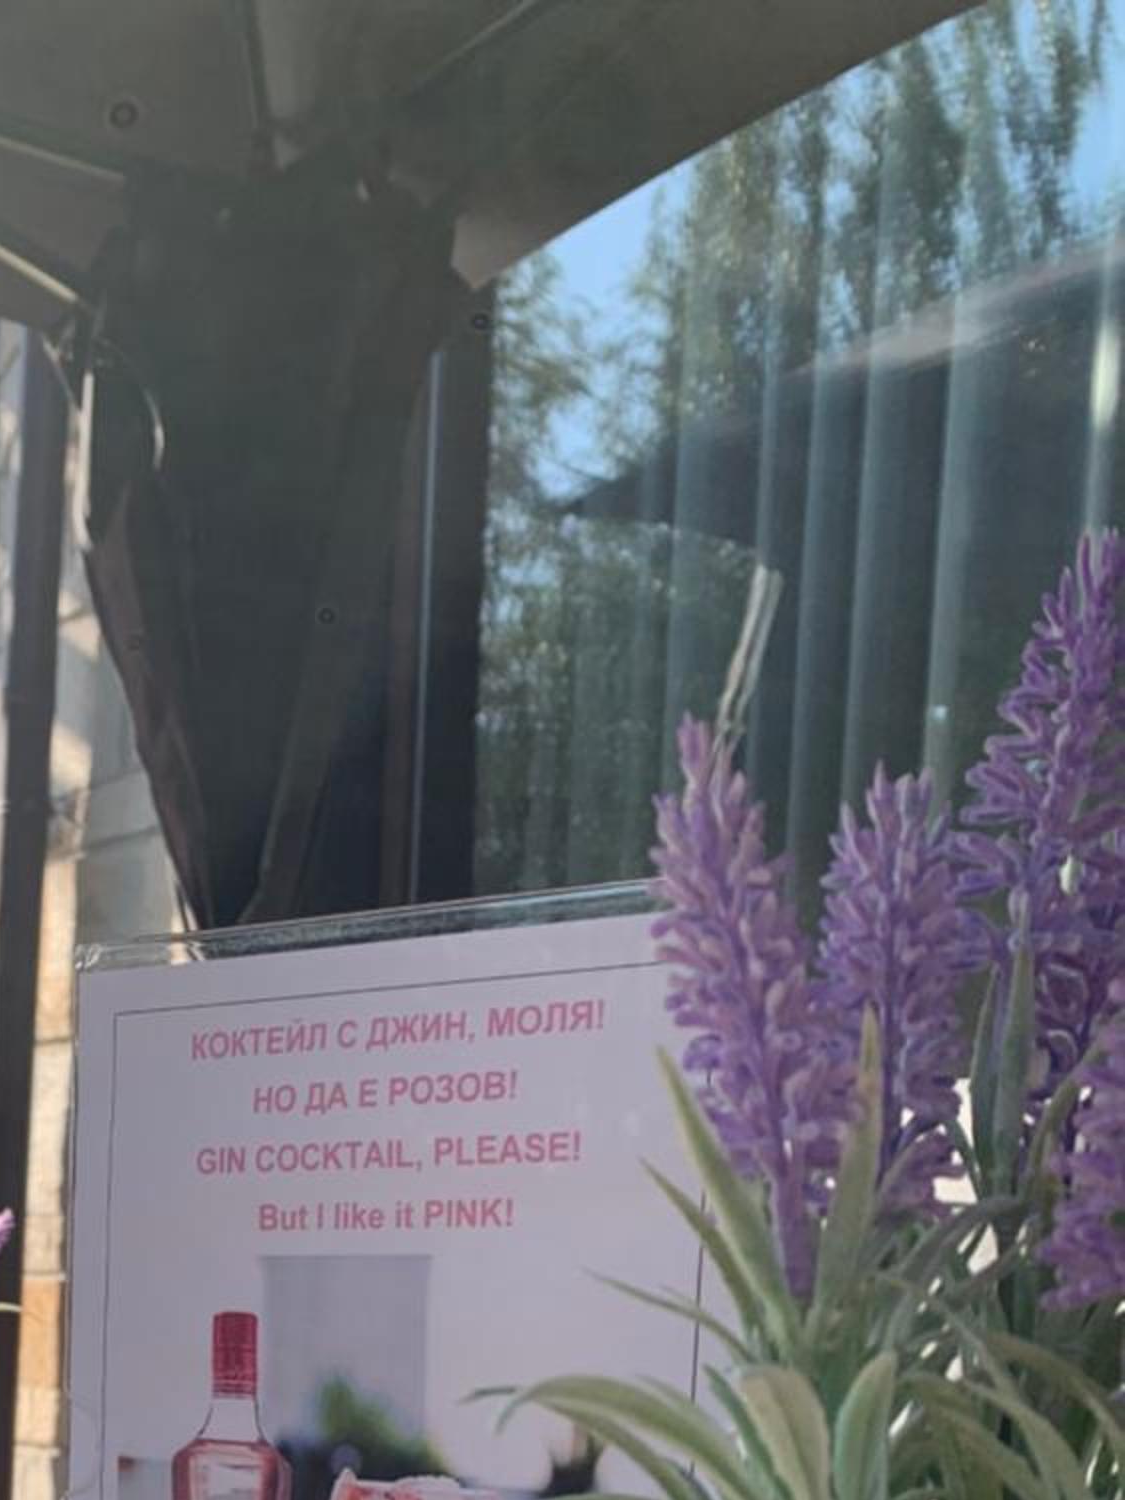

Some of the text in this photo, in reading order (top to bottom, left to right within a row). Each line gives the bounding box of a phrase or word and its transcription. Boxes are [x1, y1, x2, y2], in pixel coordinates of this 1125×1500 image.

[191, 1018, 328, 1060] КОКТЕЙЛ
[365, 1010, 475, 1051] ДЖИН,
[487, 999, 605, 1037] МОЛЯ!
[253, 1084, 297, 1114] НО
[304, 1082, 348, 1116] ДА
[388, 1070, 518, 1106] РОЗОВ!
[196, 1131, 581, 1175] GIN COCKTAIL, PLEASE!
[258, 1197, 514, 1232] But I like it PINK!
